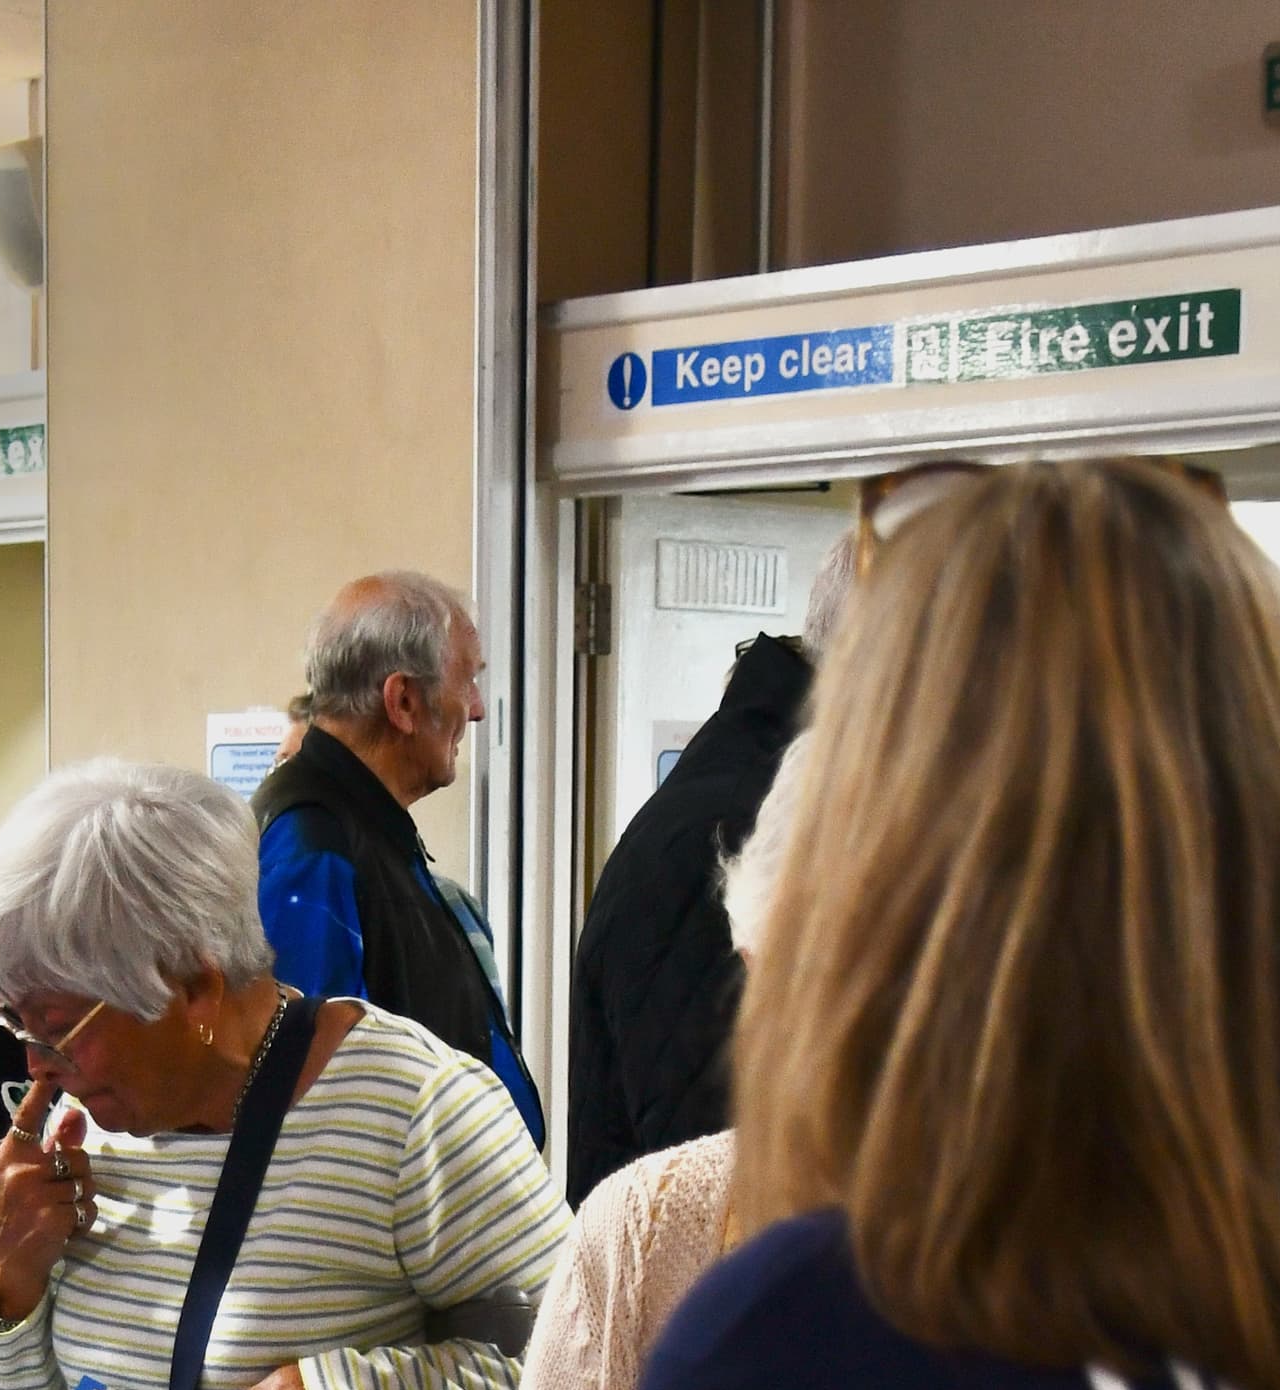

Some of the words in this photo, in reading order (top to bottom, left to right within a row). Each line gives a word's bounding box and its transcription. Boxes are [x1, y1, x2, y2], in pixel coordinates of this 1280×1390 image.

[984, 318, 1090, 376] Fire
[1107, 302, 1215, 357] exit
[674, 351, 766, 393] Keep
[779, 340, 873, 380] clear
[7, 434, 45, 471] ex
